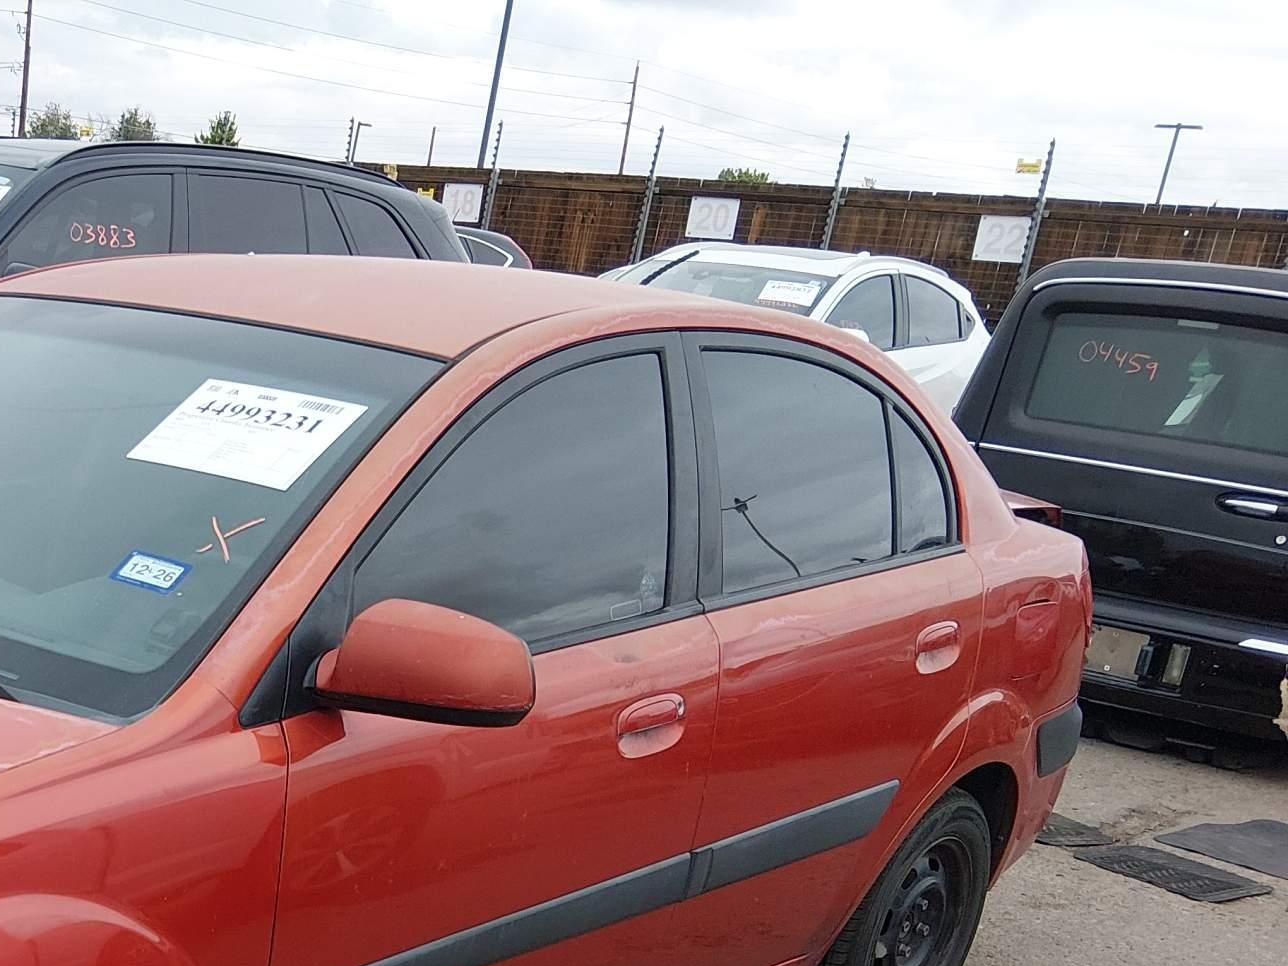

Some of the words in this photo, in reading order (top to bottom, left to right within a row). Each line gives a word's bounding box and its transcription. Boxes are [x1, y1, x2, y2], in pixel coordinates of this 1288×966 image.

[450, 189, 475, 215] 18
[695, 203, 730, 232] 20
[70, 222, 136, 248] 03883
[982, 223, 1026, 254] 22
[1079, 340, 1160, 382] 04459
[196, 399, 323, 433] 44993231
